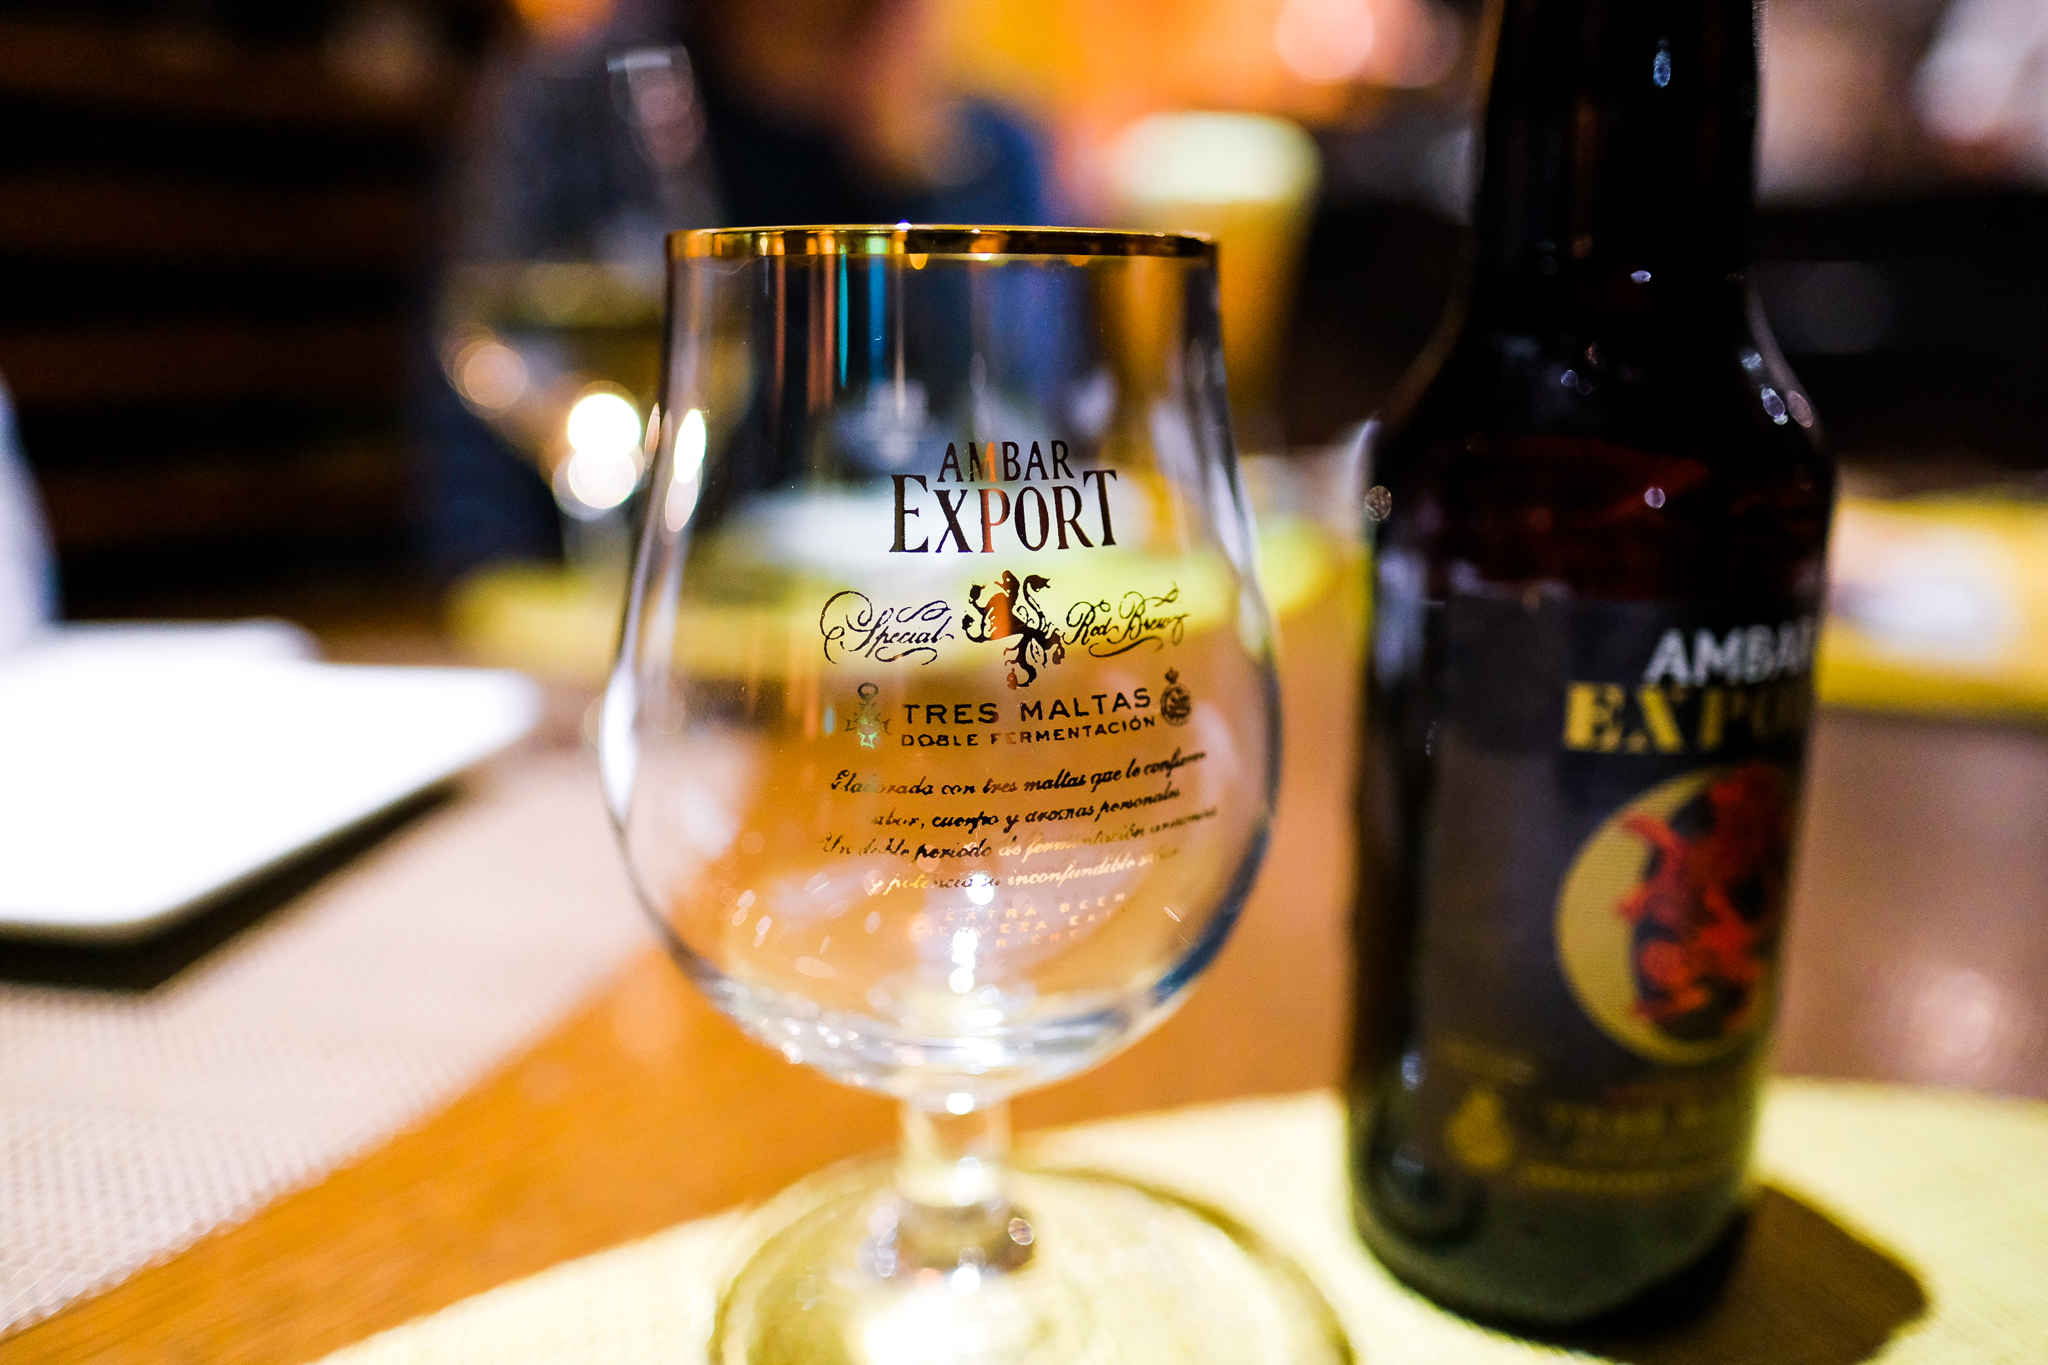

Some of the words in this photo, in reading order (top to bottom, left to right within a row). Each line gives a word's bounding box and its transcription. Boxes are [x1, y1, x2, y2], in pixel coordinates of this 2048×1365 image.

[937, 440, 1075, 483] AMBAR
[888, 468, 1118, 554] EXPORT
[819, 590, 954, 666] Special
[1061, 600, 1119, 646] Red
[903, 702, 1000, 725] TRES
[1020, 687, 1152, 722] MALTAS
[901, 733, 979, 747] DOBLE
[990, 715, 1156, 746] FERMENTACIÓN
[831, 769, 934, 796] Elaborada
[941, 783, 976, 796] con
[983, 777, 1018, 794] tres
[1023, 768, 1087, 792] maltas
[1090, 769, 1123, 793] que
[1003, 814, 1019, 834] y
[910, 838, 993, 865] periodo
[1007, 851, 1136, 888] inconfundible
